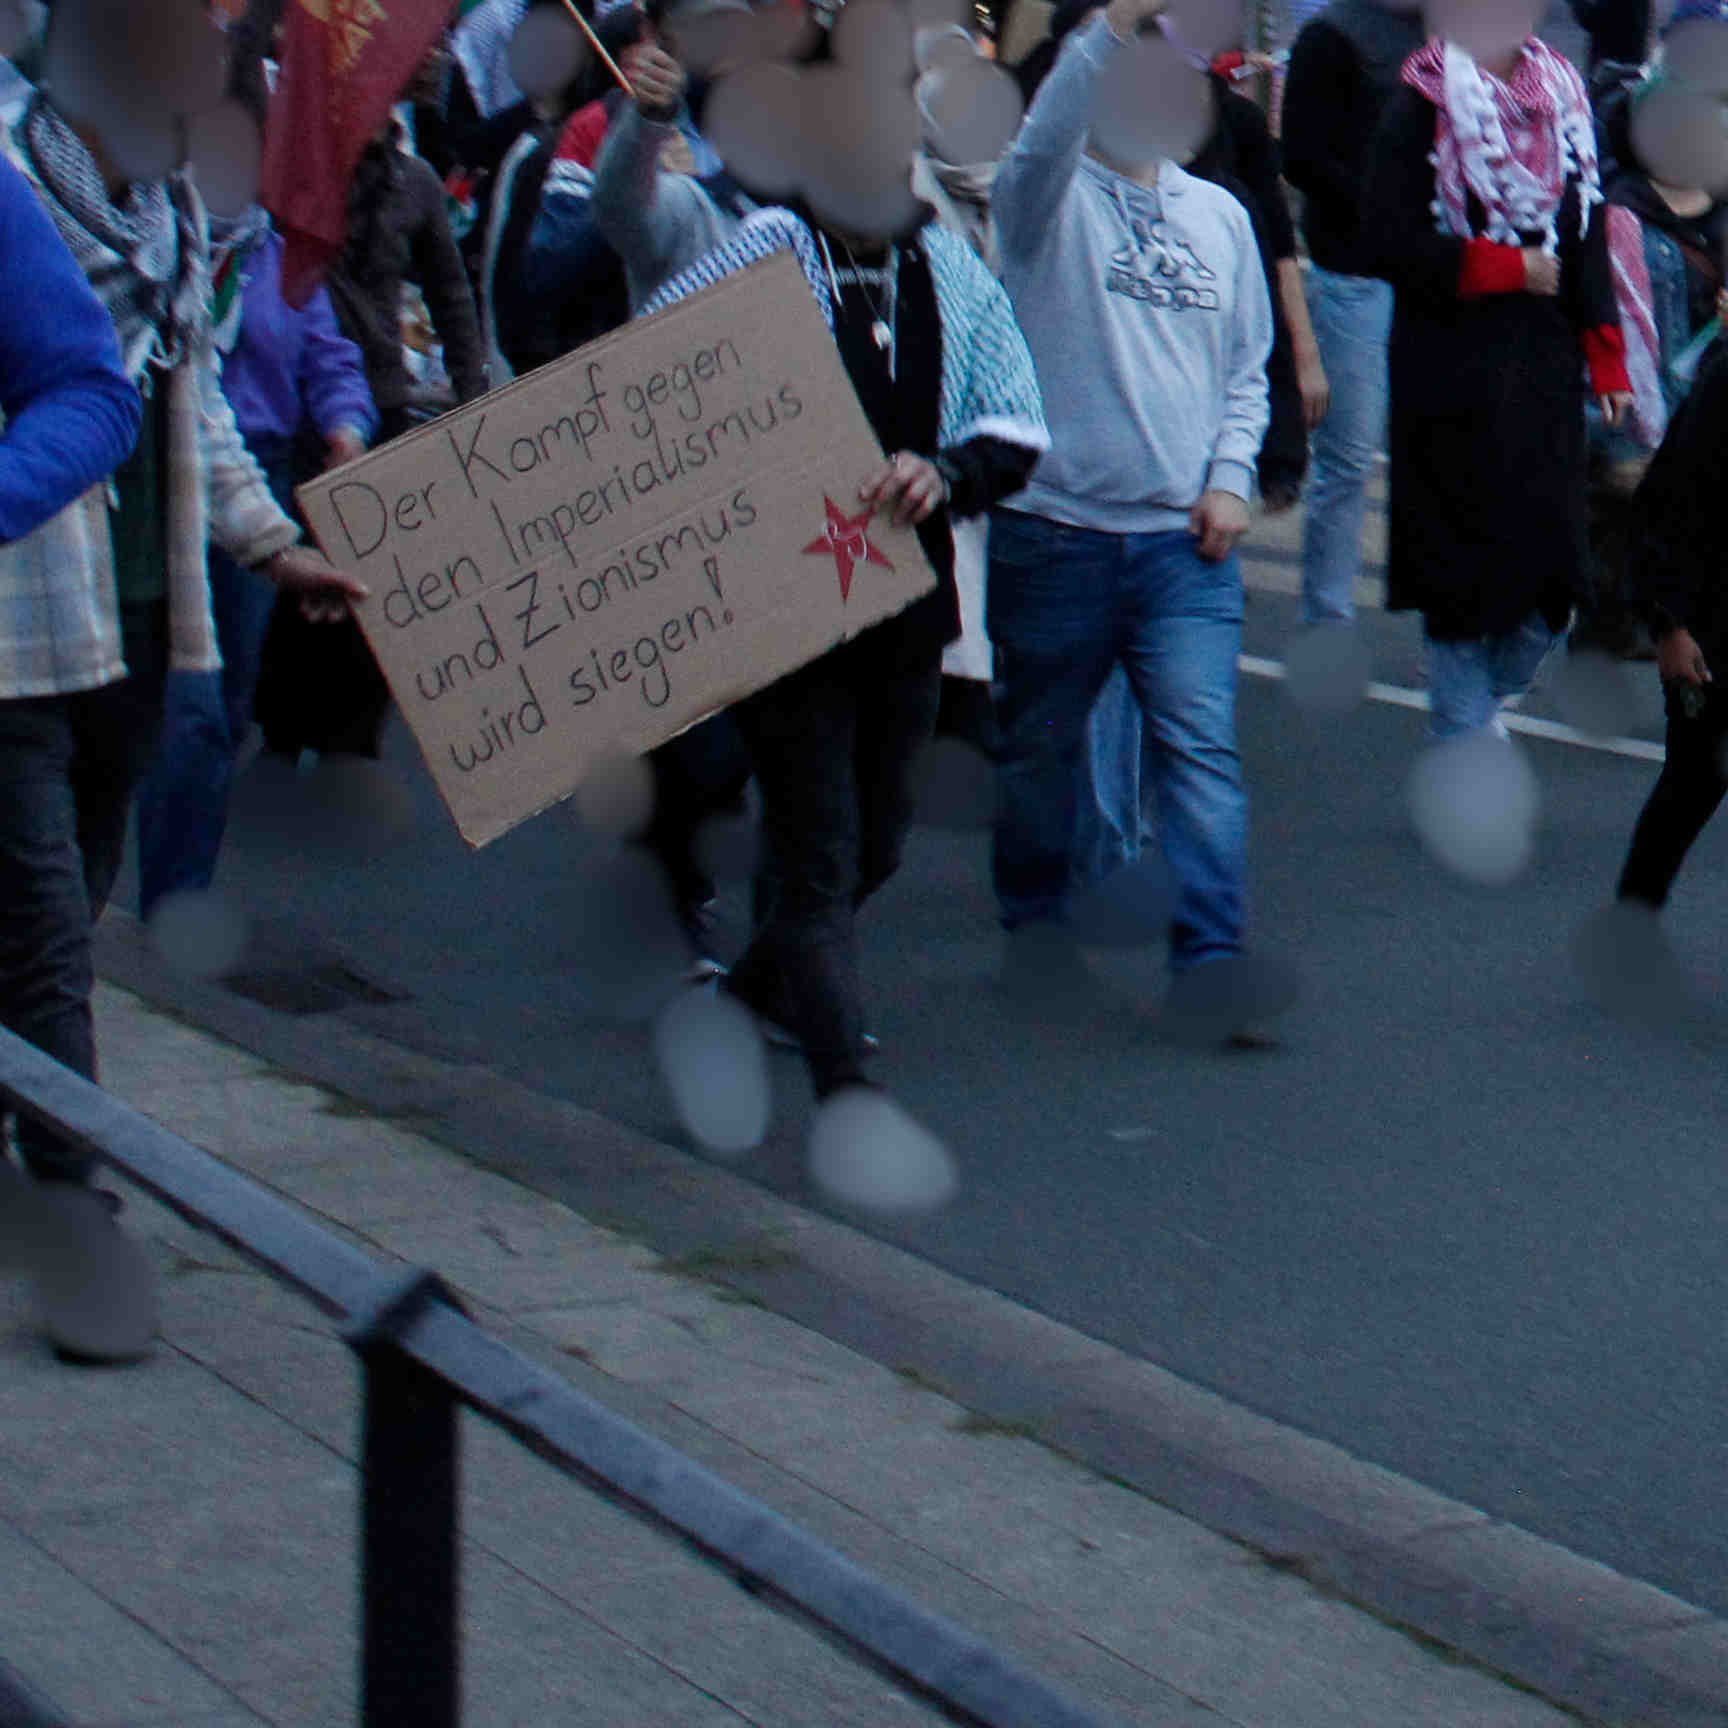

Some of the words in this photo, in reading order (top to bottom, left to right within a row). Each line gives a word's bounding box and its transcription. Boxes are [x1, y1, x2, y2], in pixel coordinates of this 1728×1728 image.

[328, 480, 437, 560] Der
[447, 361, 611, 499] Kampf
[623, 337, 743, 440] gegen
[383, 553, 484, 628] den
[490, 383, 803, 569] Imperialismus
[415, 603, 505, 701] und
[505, 489, 758, 650] Zionismus
[449, 663, 548, 772] wird
[570, 555, 734, 709] siegen!
